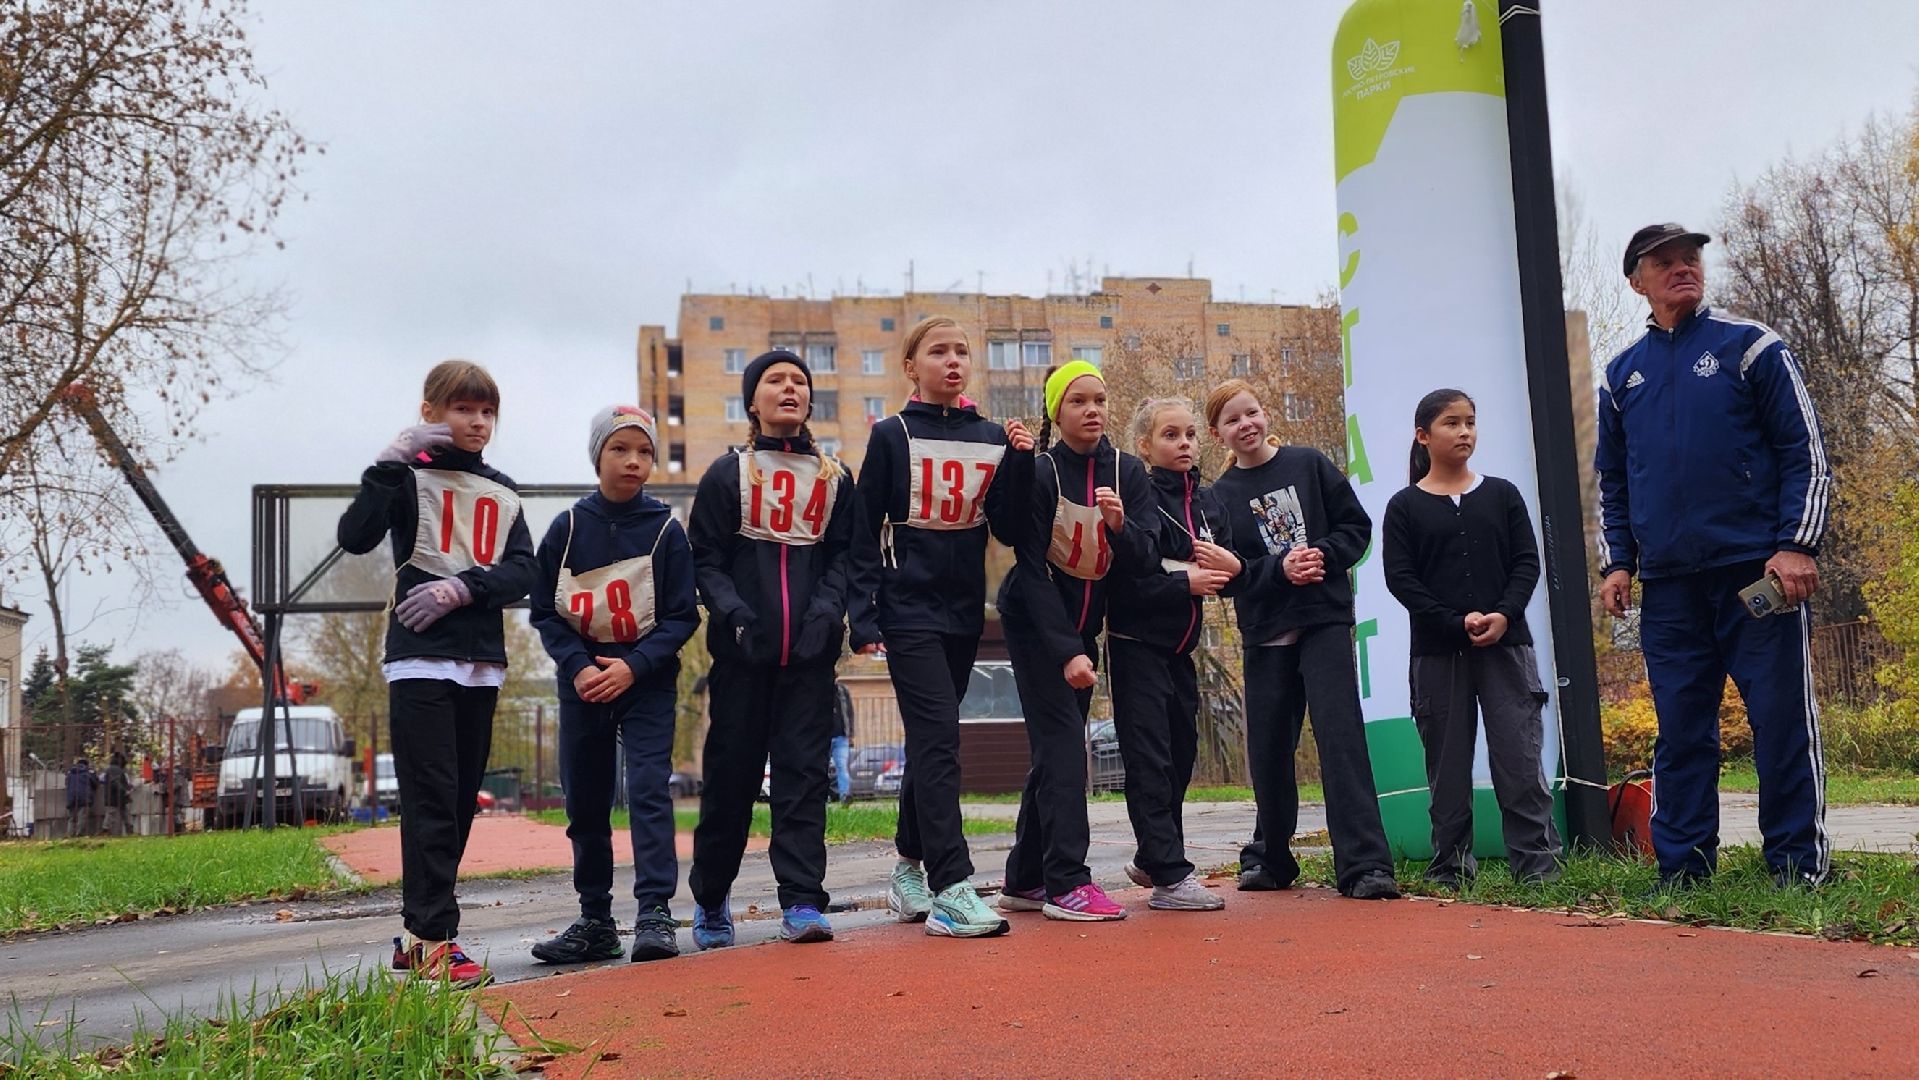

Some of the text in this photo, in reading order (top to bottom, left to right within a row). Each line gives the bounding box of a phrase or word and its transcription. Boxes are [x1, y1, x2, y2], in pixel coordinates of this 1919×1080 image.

[1356, 80, 1391, 101] ПАРКИ
[750, 469, 827, 536] 134
[920, 458, 996, 523] 137
[440, 489, 499, 566] 10
[570, 579, 638, 643] 28
